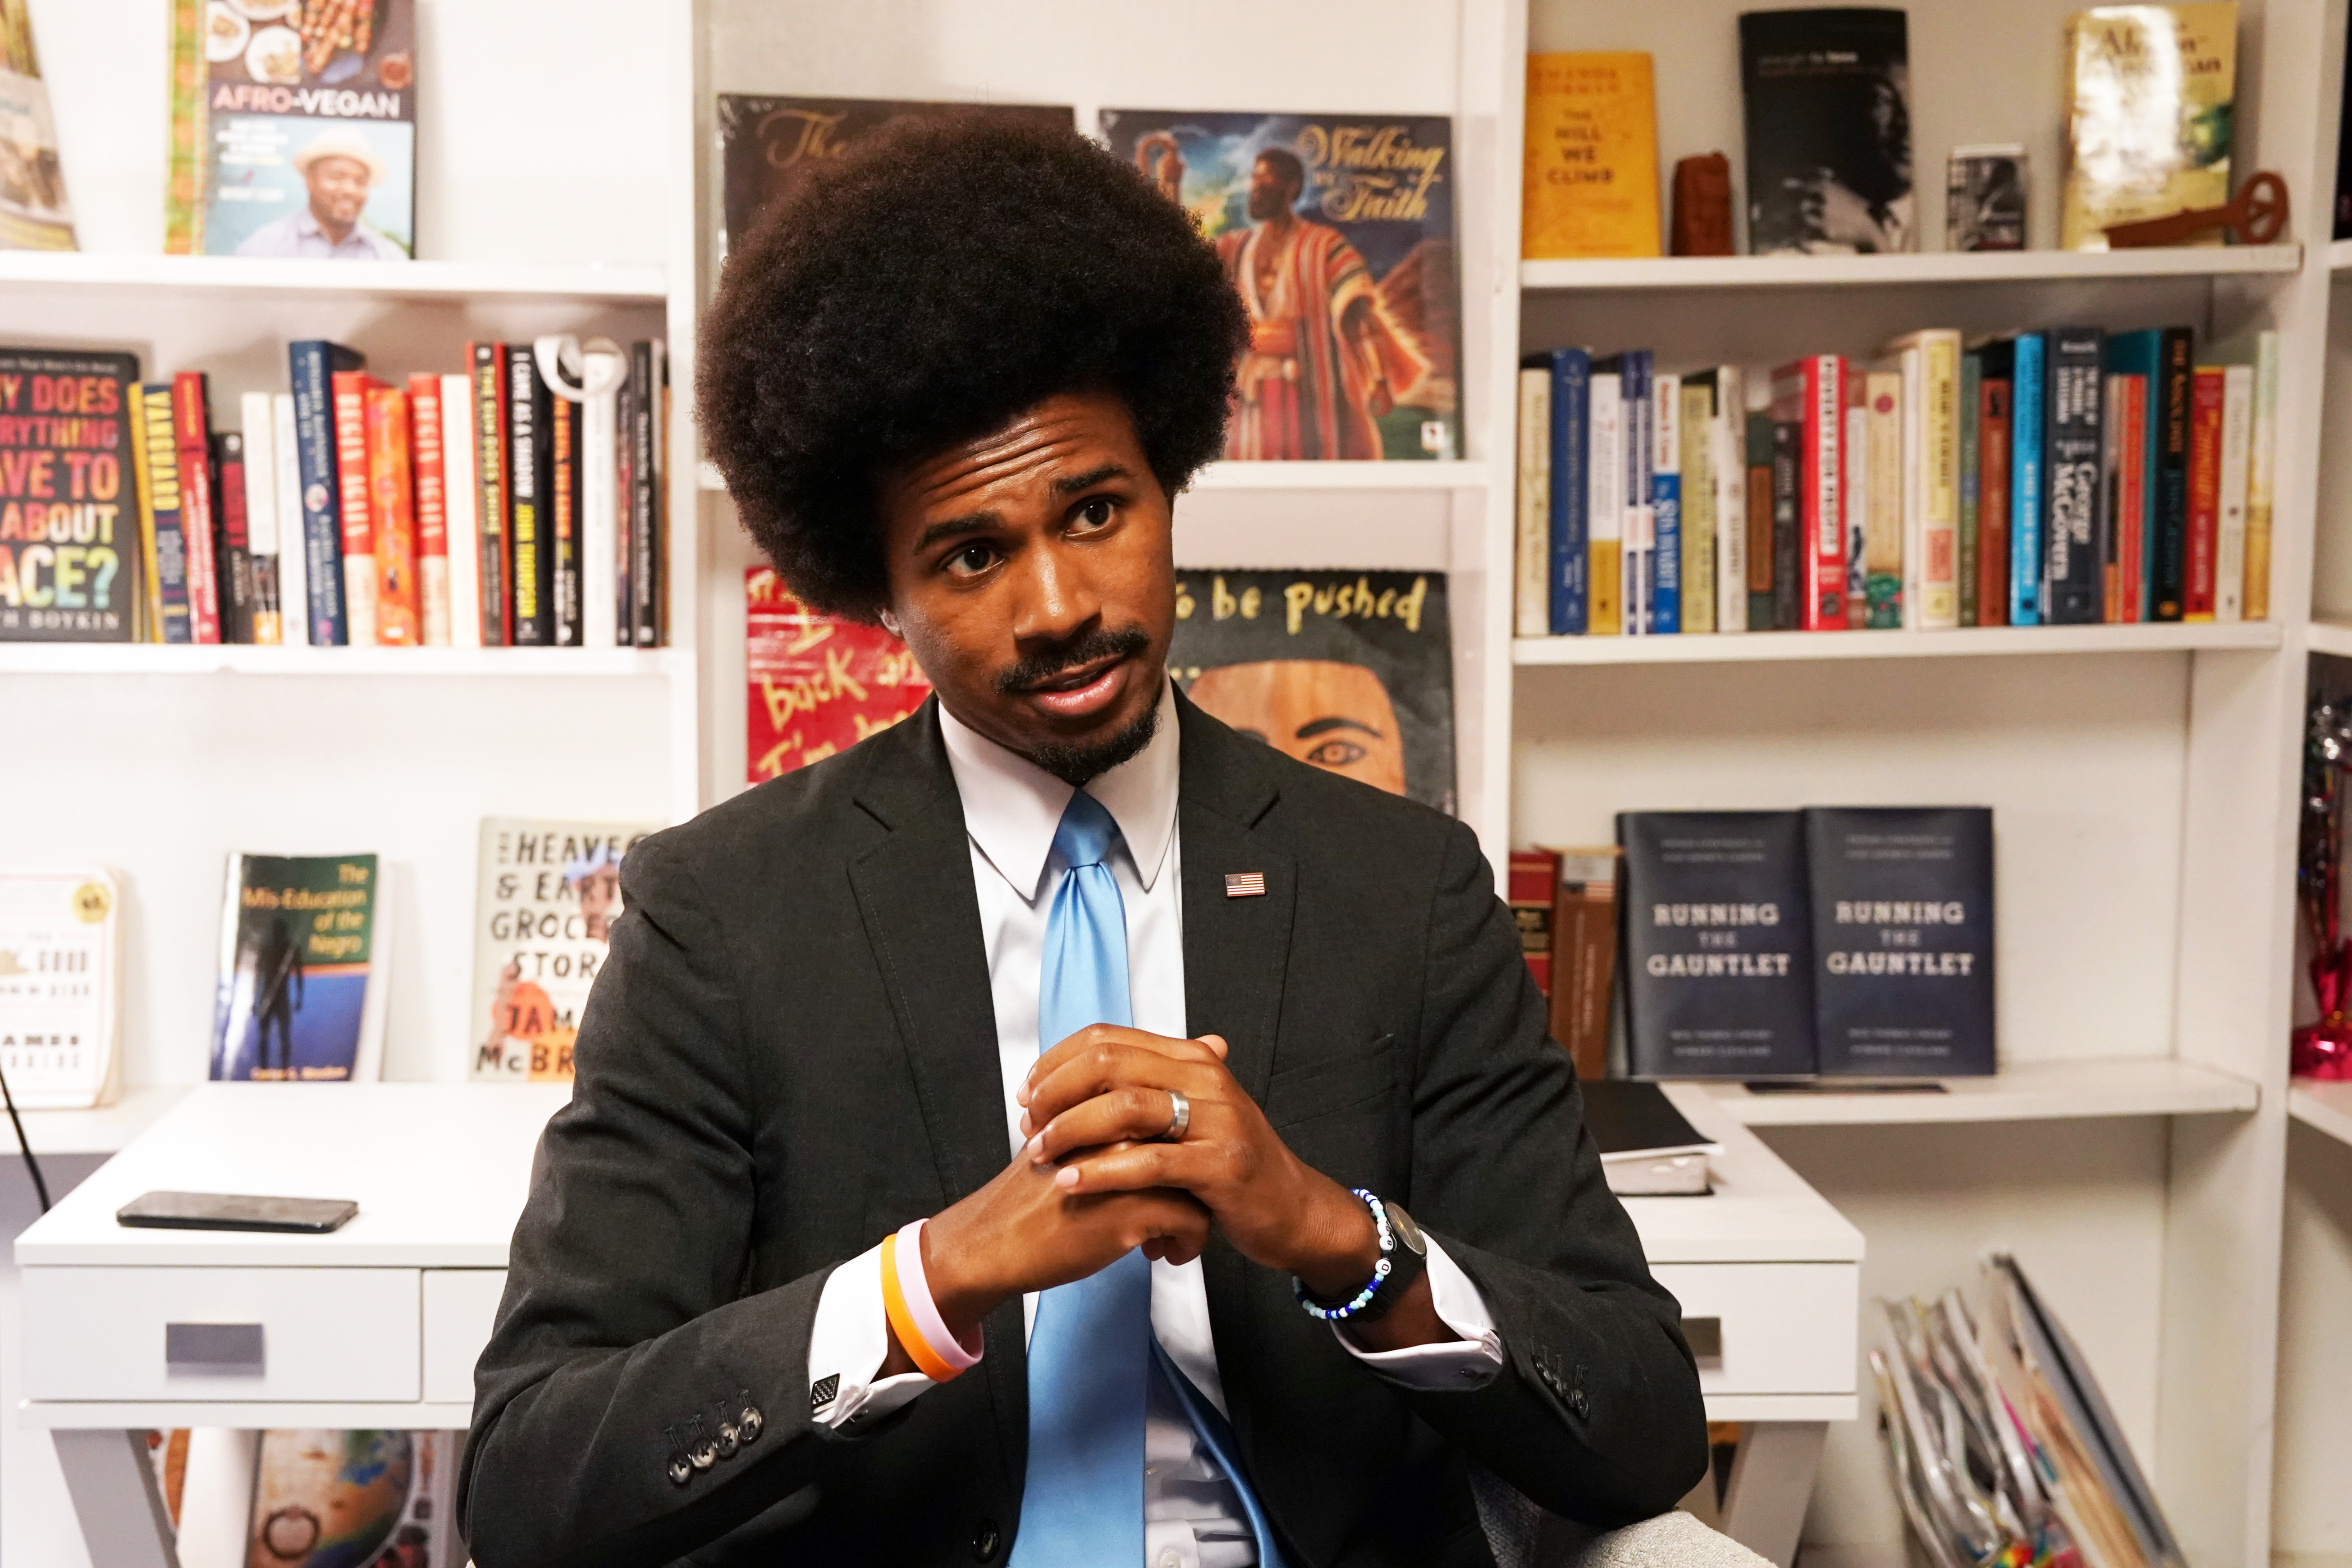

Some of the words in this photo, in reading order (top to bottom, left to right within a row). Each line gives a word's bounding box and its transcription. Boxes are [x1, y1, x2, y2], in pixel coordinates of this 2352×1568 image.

[212, 85, 400, 118] AFRO-VEGAN
[1295, 123, 1445, 197] Walking
[1321, 173, 1429, 222] Faith
[32, 375, 119, 415] DOES
[0, 449, 55, 498] VE
[62, 452, 120, 500] TO
[2073, 461, 2098, 544] George
[1, 500, 119, 544] ABOUT
[2052, 462, 2075, 580] McGovern
[28, 610, 119, 631] BOYKIN
[1213, 575, 1261, 620] be
[1284, 575, 1428, 635] pushed
[517, 830, 648, 864] HEAVE
[338, 863, 369, 884] The
[496, 872, 519, 901] &
[535, 872, 620, 902] EART
[242, 886, 367, 910] Mis-Education
[1835, 901, 1966, 925] RUNNING
[313, 912, 334, 932] of
[335, 911, 365, 930] the
[490, 909, 618, 940] GROCE
[1652, 903, 1780, 927] RUNNING
[309, 933, 362, 959] Negro
[513, 951, 597, 981] STOR
[1646, 953, 1790, 977] GAUNTLET
[1826, 951, 1975, 976] GAUNTLET
[505, 1003, 573, 1034] JAM
[476, 1044, 574, 1075] McBR
